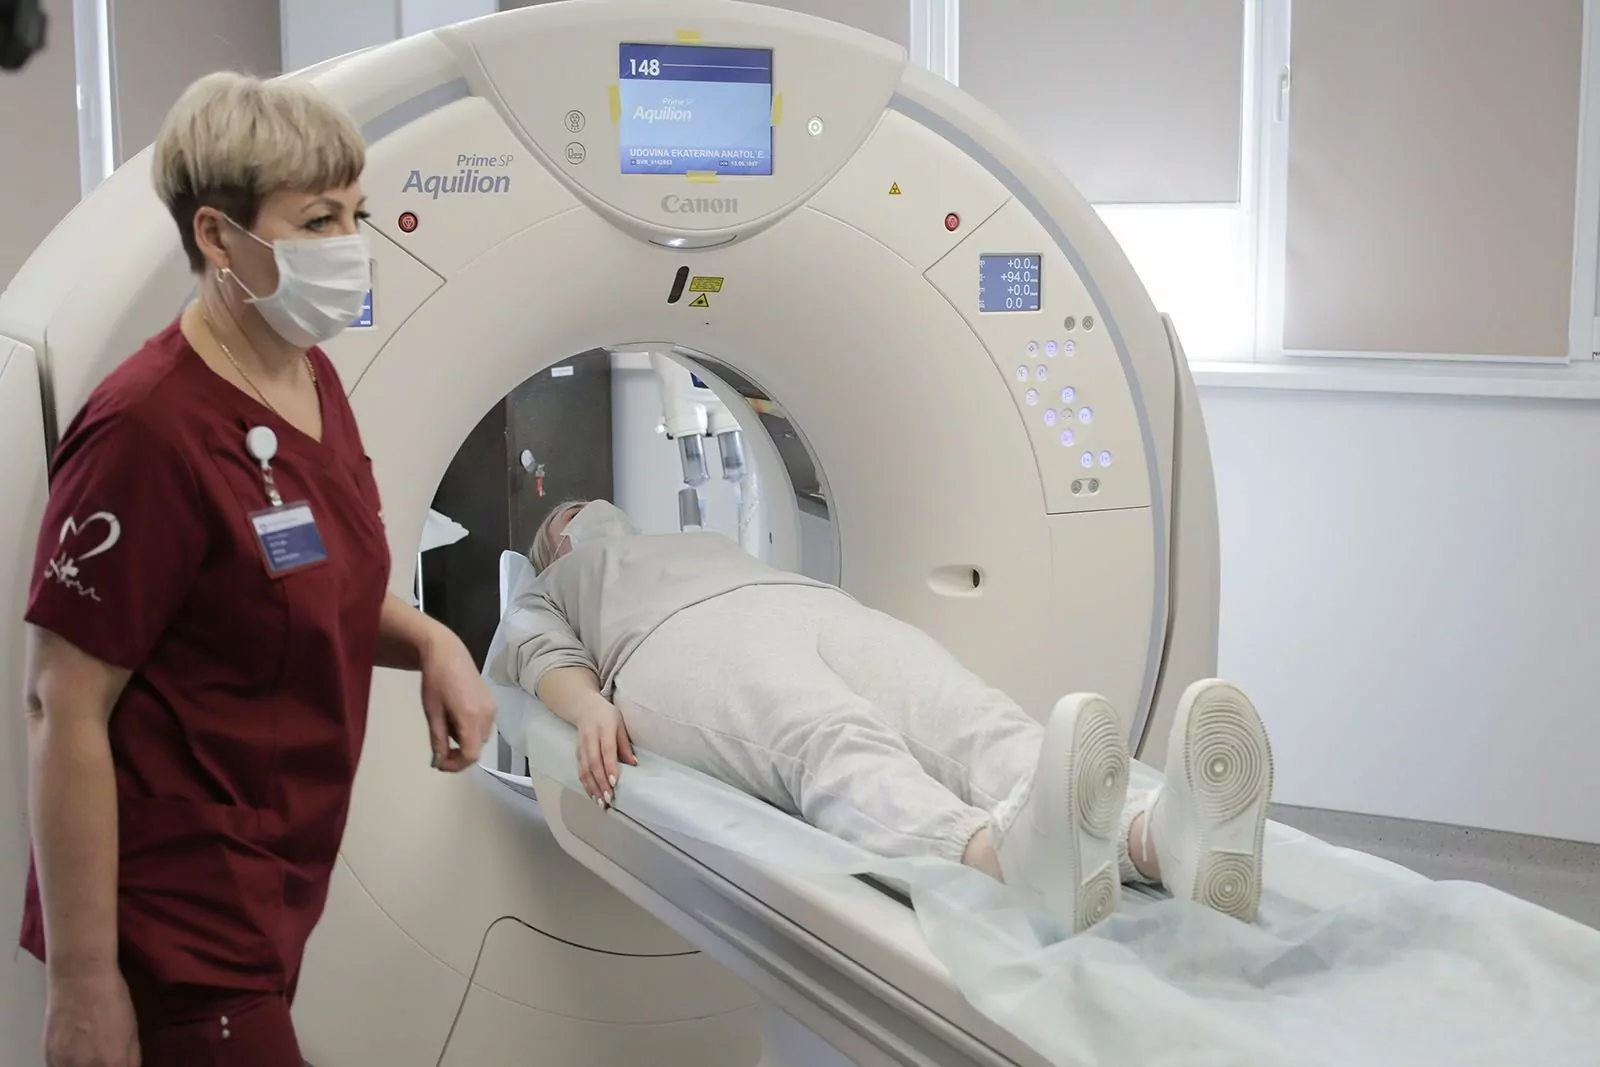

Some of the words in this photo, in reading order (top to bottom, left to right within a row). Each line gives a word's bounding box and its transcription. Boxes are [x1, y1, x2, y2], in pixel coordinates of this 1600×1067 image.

[629, 59, 661, 76] 148
[632, 105, 692, 124] Aquilion
[456, 153, 497, 167] Prime
[499, 154, 514, 167] SP
[630, 148, 669, 157] UDOVINA
[671, 148, 720, 158] EKATERINA
[401, 169, 511, 200] Aquilion
[661, 194, 738, 214] Canon
[1000, 271, 1031, 283] +94.0
[1005, 297, 1023, 309] 0.0
